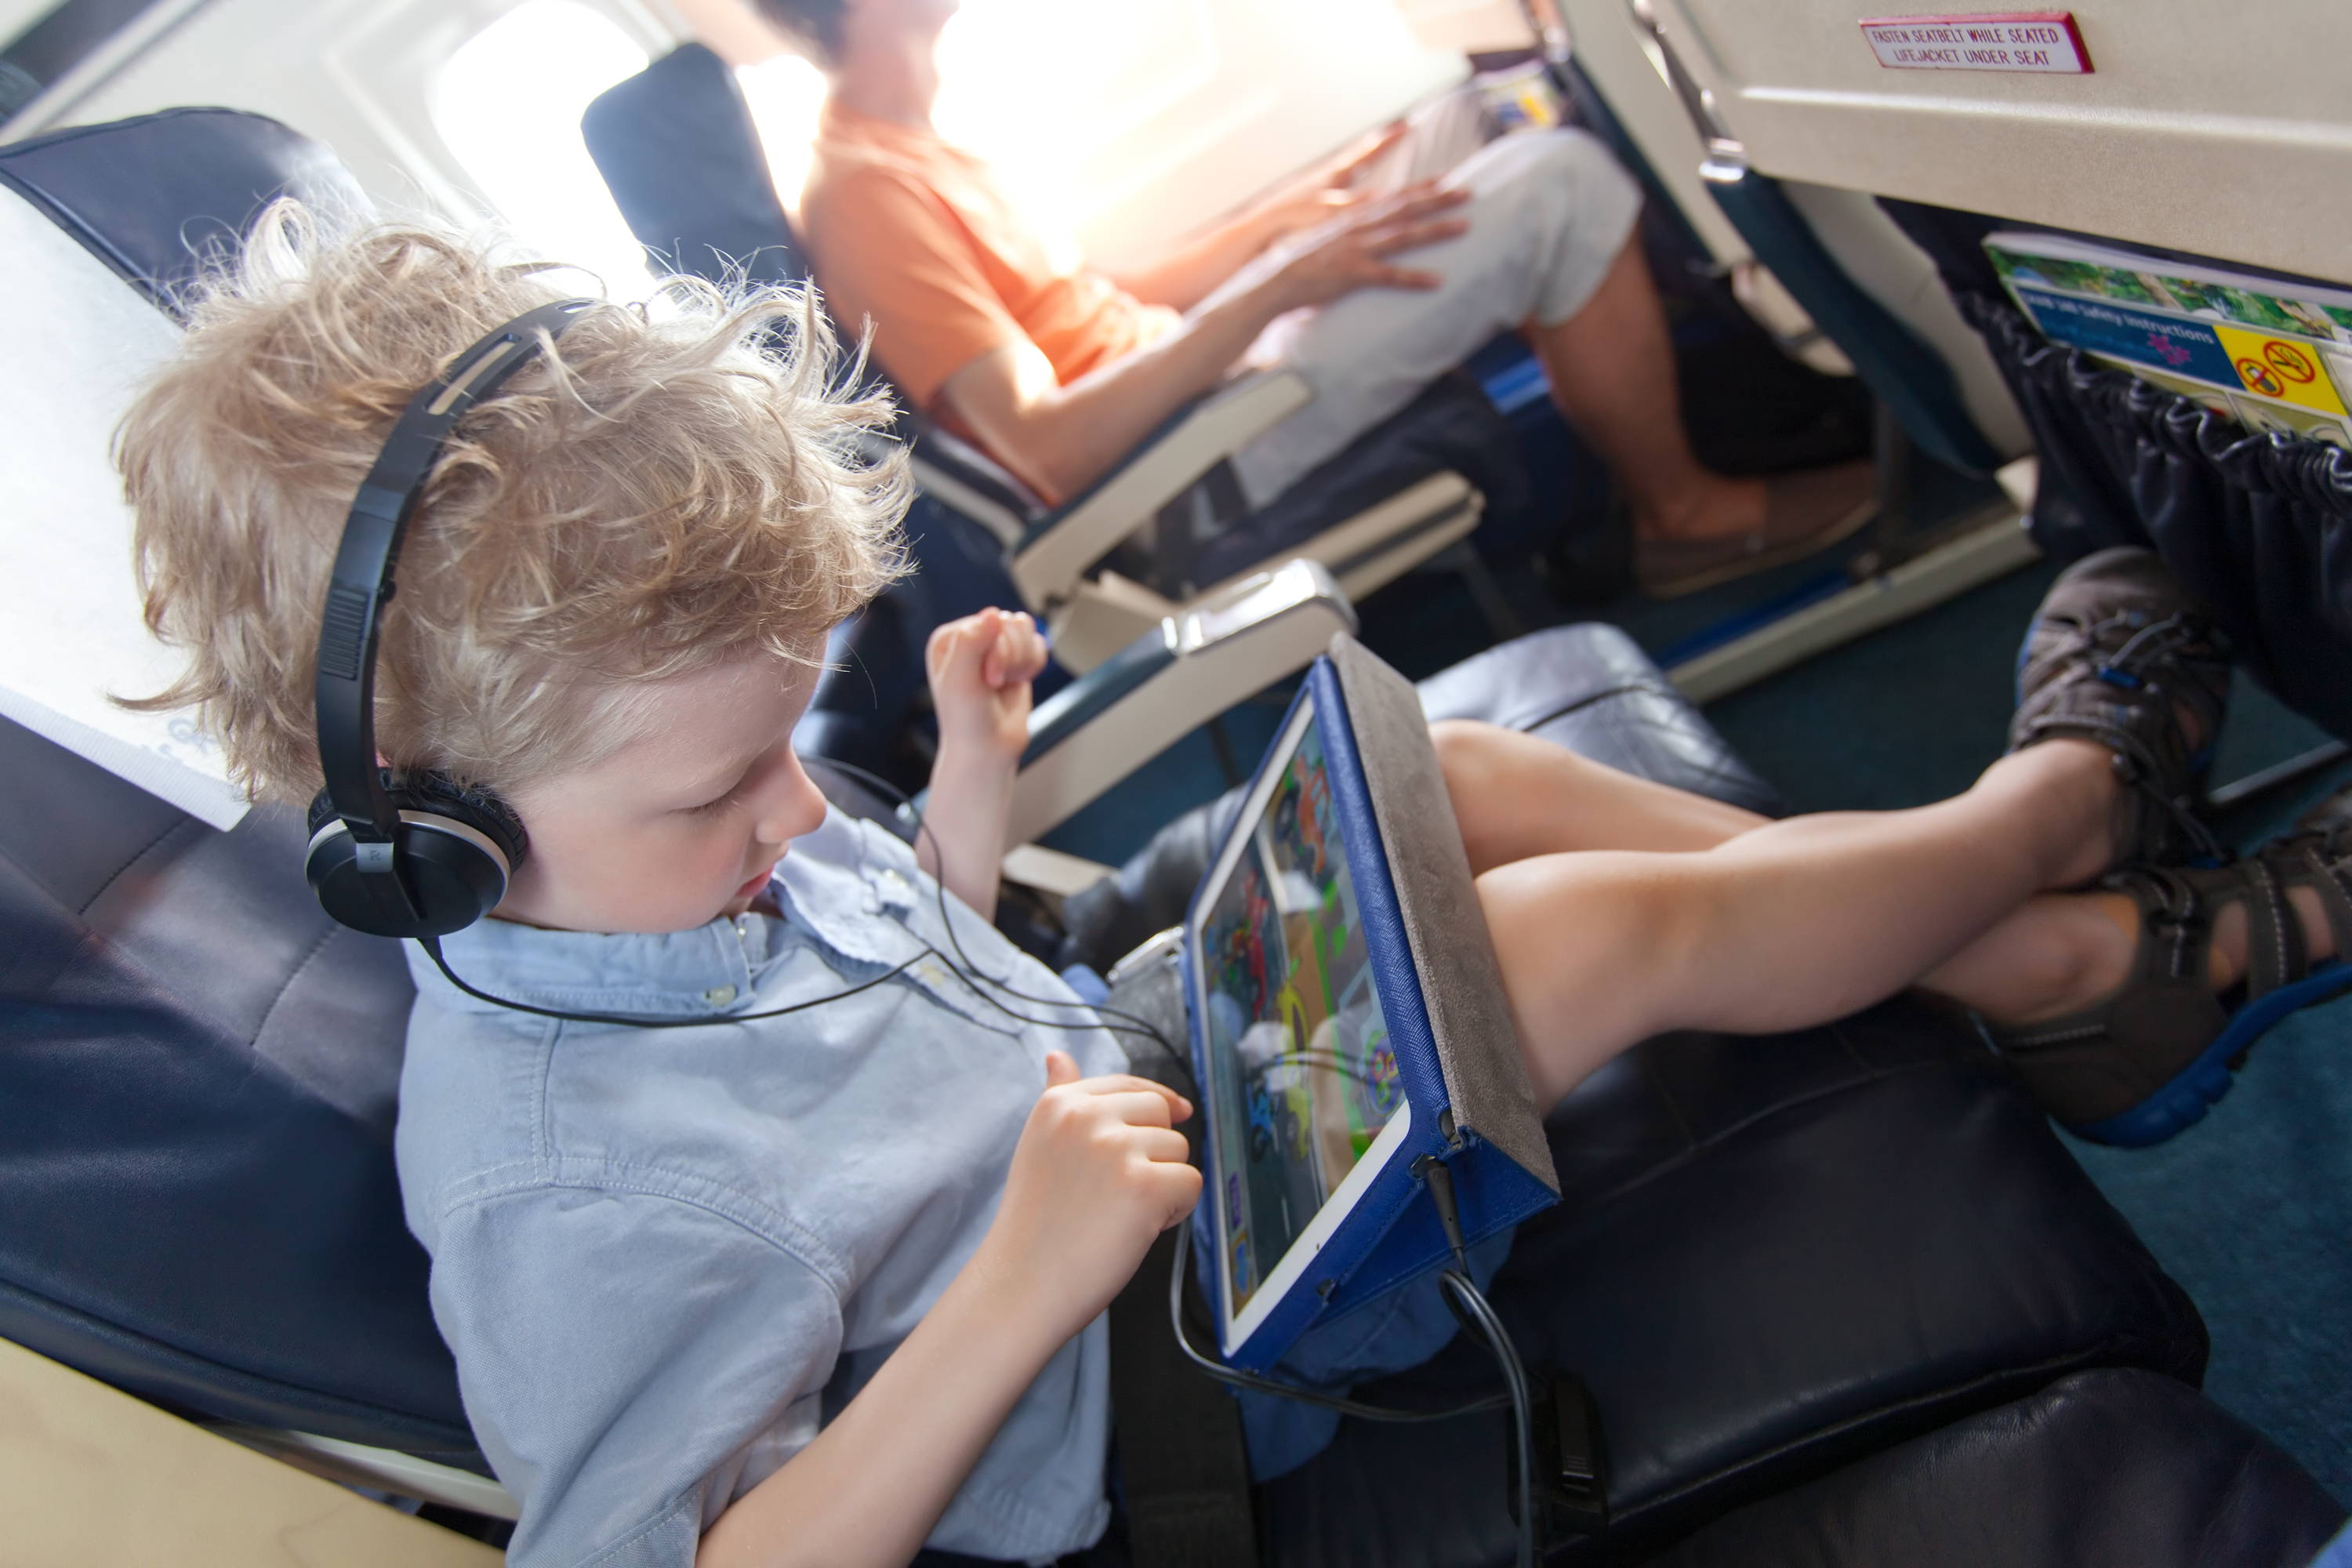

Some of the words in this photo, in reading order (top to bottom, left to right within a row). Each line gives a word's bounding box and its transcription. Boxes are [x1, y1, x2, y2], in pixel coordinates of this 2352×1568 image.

[1871, 30, 1910, 44] FASTEN
[1911, 29, 1965, 44] SEATBELT
[1966, 29, 2005, 44] WHILE
[2009, 28, 2060, 44] SEATED
[1893, 49, 1960, 64] LIFEJACKET
[1964, 49, 2009, 65] UNDER
[2014, 50, 2050, 66] SEAT
[2125, 316, 2215, 344] Instructions
